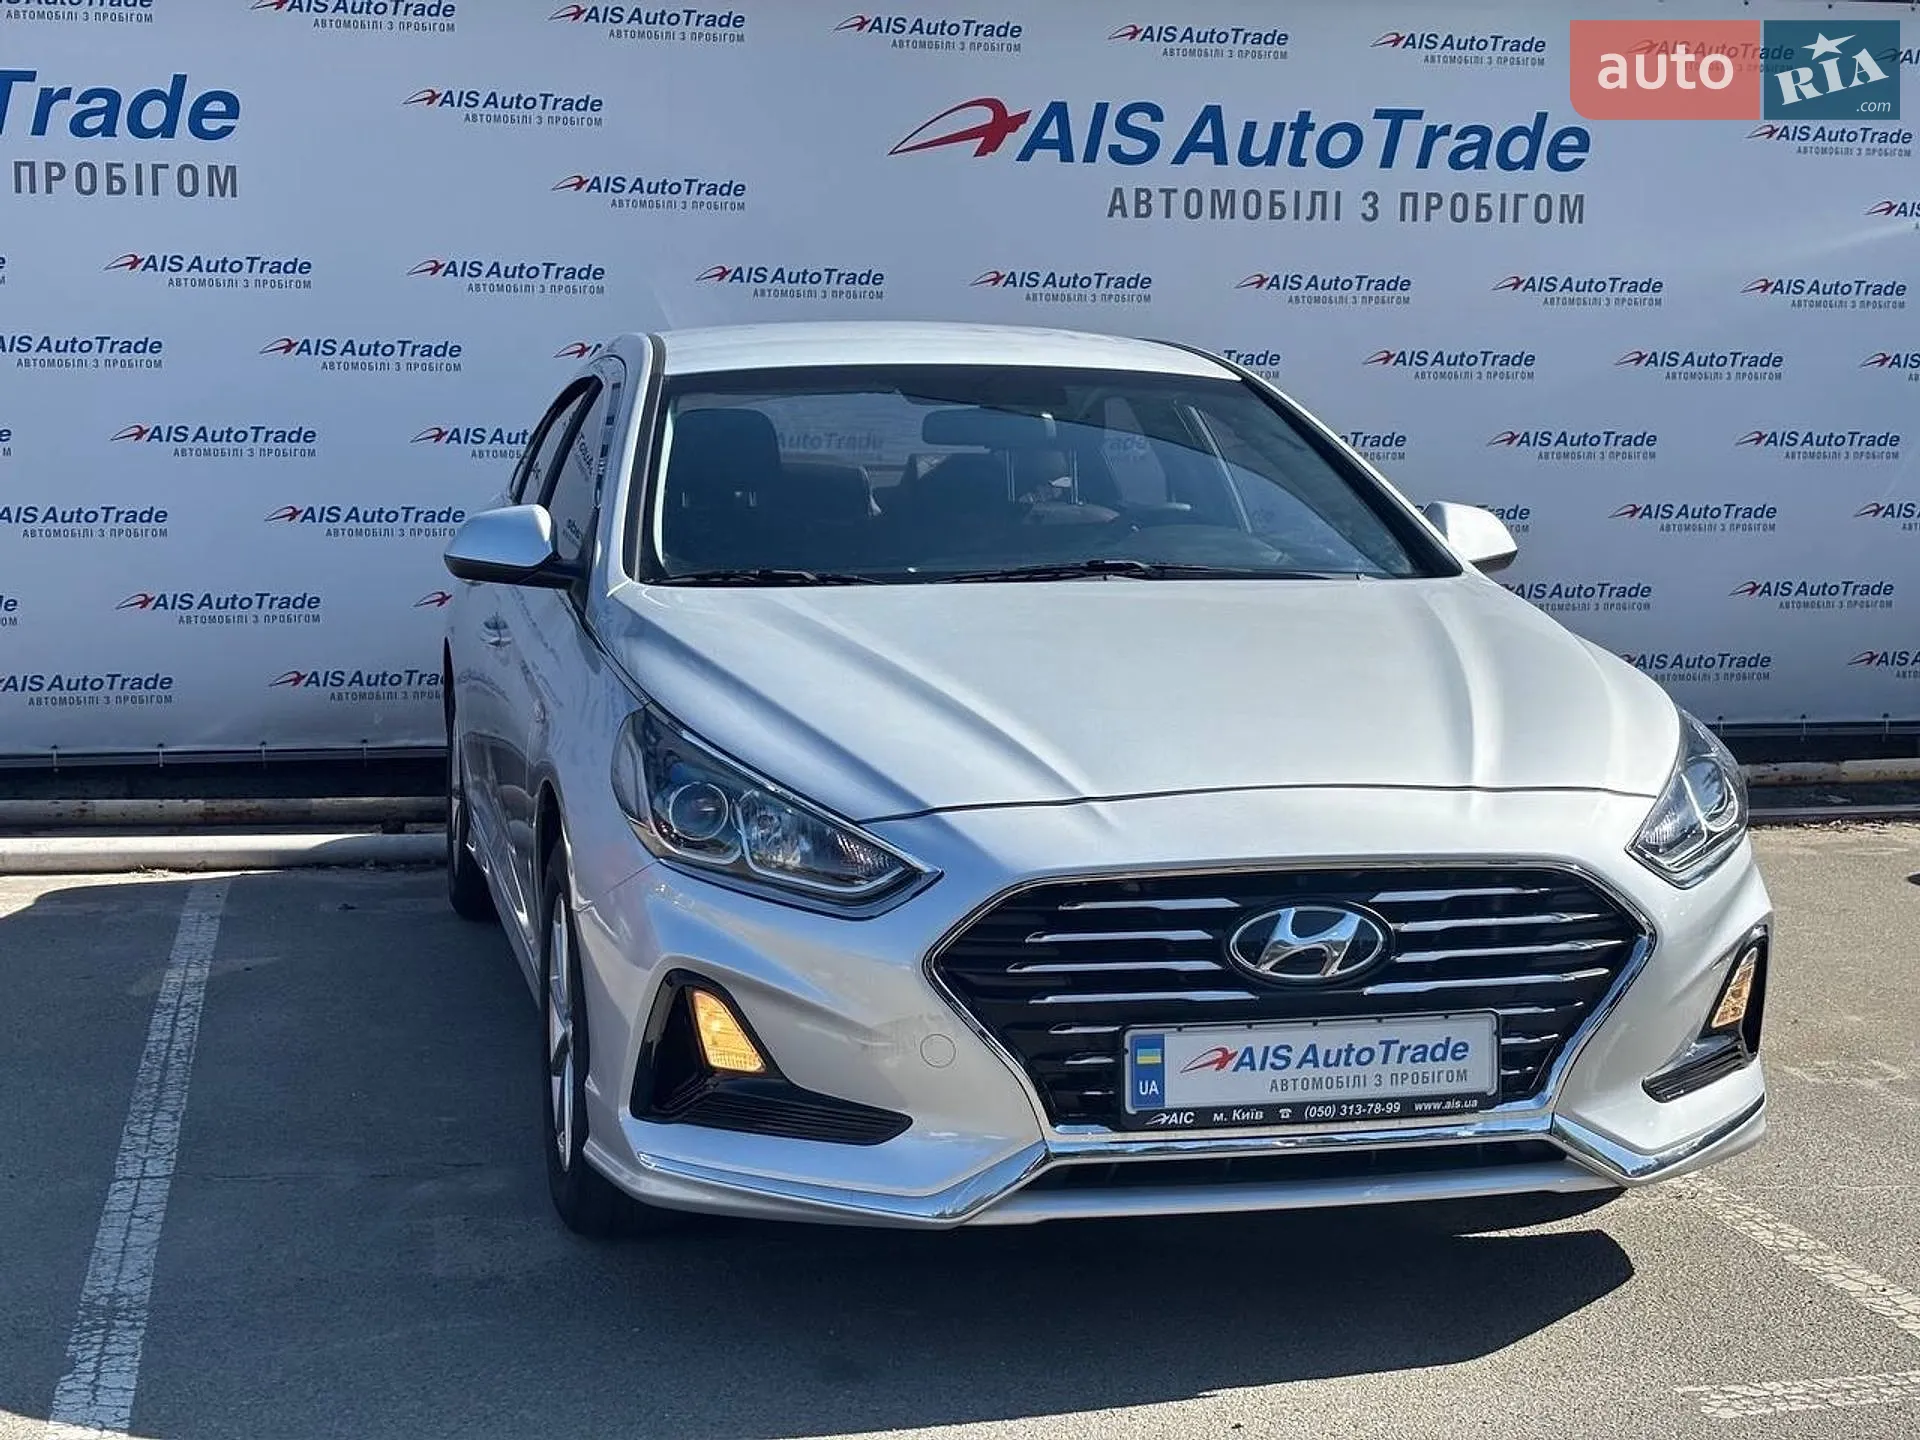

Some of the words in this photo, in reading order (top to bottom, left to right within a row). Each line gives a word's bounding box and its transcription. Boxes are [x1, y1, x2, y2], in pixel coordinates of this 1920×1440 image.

[6, 10, 78, 21] АВТОМОБІЛІ
[94, 12, 153, 23] ПРОБІГОМ
[286, 0, 328, 13] AIS
[332, 0, 455, 17] AutoTrade
[584, 6, 627, 24] AIS
[627, 7, 744, 28] AutoTrade
[314, 18, 382, 30] АВТОМОБІЛІ
[399, 21, 455, 33] ПРОБІГОМ
[868, 16, 909, 34] AIS
[910, 18, 1022, 38] AutoTrade
[609, 29, 675, 40] АВТОМОБІЛІ
[690, 32, 744, 43] ПРОБІГОМ
[1139, 25, 1177, 43] AIS
[1179, 27, 1288, 46] AutoTrade
[1405, 33, 1443, 50] AIS
[1443, 34, 1546, 52] AutoTrade
[891, 39, 955, 50] АВТОМОБІЛІ
[970, 42, 1020, 52] ПРОБІГОМ
[1162, 47, 1223, 58] АВТОМОБІЛІ
[1238, 49, 1287, 60] ПРОБІГОМ
[437, 90, 480, 108] AIS
[482, 92, 602, 112] AutoTrade
[464, 113, 532, 124] АВТОМОБІЛІ
[548, 116, 602, 127] ПРОБІГОМ
[1014, 101, 1165, 166] AIS
[1171, 105, 1591, 172] AutoTrade
[1775, 125, 1812, 141] AIS
[1812, 126, 1912, 143] AutoTrade
[13, 160, 239, 198] ПРОБІГОМ
[585, 176, 626, 194] AIS
[628, 178, 746, 196] AutoTrade
[611, 200, 679, 209] АВТОМОБІЛІ
[692, 200, 744, 211] ПРОБІГОМ
[1107, 187, 1342, 221] АВТОМОБІЛІ
[1361, 190, 1380, 222] З
[1399, 191, 1585, 224] ПРОБІГОМ
[1894, 202, 1920, 217] AI
[141, 255, 187, 272] AIS
[187, 256, 311, 274] AutoTrade
[441, 260, 483, 278] AIS
[485, 262, 604, 280] AutoTrade
[168, 277, 238, 288] АВТОМОБІЛІ
[254, 279, 311, 289] ПРОБІГОМ
[730, 266, 771, 283] AIS
[772, 268, 884, 286] AutoTrade
[1002, 272, 1040, 288] AIS
[1042, 272, 1152, 289] AutoTrade
[1267, 275, 1306, 290] AIS
[1306, 275, 1411, 291] AutoTrade
[468, 283, 536, 293] АВТОМОБІЛІ
[550, 284, 604, 295] ПРОБІГОМ
[1521, 276, 1558, 292] AIS
[1559, 277, 1663, 293] AutoTrade
[1769, 279, 1805, 295] AIS
[1807, 280, 1906, 296] AutoTrade
[753, 288, 819, 298] АВТОМОБІЛІ
[832, 287, 883, 300] ПРОБІГОМ
[1025, 292, 1089, 303] АВТОМОБІЛІ
[1101, 294, 1151, 303] ПРОБІГОМ
[39, 336, 162, 354] AutoTrade
[296, 339, 340, 356] AIS
[340, 340, 461, 358] AutoTrade
[16, 358, 91, 368] АВТОМОБІЛІ
[104, 359, 162, 368] ПРОБІГОМ
[321, 361, 390, 371] АВТОМОБІЛІ
[404, 362, 461, 372] ПРОБІГОМ
[1393, 351, 1431, 366] AIS
[1431, 351, 1535, 366] AutoTrade
[1644, 351, 1682, 367] AIS
[1682, 352, 1783, 367] AutoTrade
[1414, 371, 1473, 380] АВТОМОБІЛІ
[1486, 371, 1534, 380] ПРОБІГОМ
[146, 426, 188, 442] AIS
[192, 426, 316, 443] AutoTrade
[445, 428, 486, 445] AIS
[1515, 431, 1552, 447] AIS
[1554, 431, 1657, 447] AutoTrade
[1763, 431, 1799, 447] AIS
[1800, 432, 1900, 447] AutoTrade
[174, 448, 242, 457] АВТОМОБІЛІ
[260, 448, 316, 457] ПРОБІГОМ
[1785, 451, 1840, 460] АВТОМОБІЛІ
[1853, 451, 1899, 460] ПРОБІГОМ
[0, 506, 42, 524] AIS
[42, 506, 168, 524] AutoTrade
[300, 506, 344, 523] AIS
[344, 507, 465, 523] AutoTrade
[1636, 504, 1674, 519] AIS
[1675, 504, 1776, 519] AutoTrade
[1882, 503, 1915, 518] AIS
[23, 528, 96, 538] АВТОМОБІЛІ
[110, 528, 167, 538] ПРОБІГОМ
[326, 528, 394, 537] АВТОМОБІЛІ
[410, 528, 457, 538] ПРОБІГО
[1551, 583, 1651, 598] AutoTrade
[1756, 581, 1792, 597] AIS
[1794, 581, 1894, 596] AutoTrade
[151, 593, 194, 610] AIS
[197, 592, 320, 610] AutoTrade
[1631, 654, 1668, 670] AIS
[1669, 653, 1771, 669] AutoTrade
[1876, 651, 1909, 667] AIS
[2, 675, 48, 692] AIS
[48, 673, 173, 692] AutoTrade
[304, 671, 347, 688] AIS
[1232, 1044, 1293, 1072] AIS
[1296, 1036, 1470, 1069] AutoTrade
[1139, 1080, 1159, 1095] UA
[1269, 1075, 1367, 1092] АВТОМОБІЛІ
[1374, 1074, 1383, 1087] З
[1390, 1069, 1468, 1086] ПРОБІГОМ
[1232, 1108, 1264, 1121] Київ
[1304, 1104, 1336, 1120] (050)
[1339, 1102, 1401, 1117] 313-78-99
[1414, 1099, 1478, 1113] www.ais.ua
